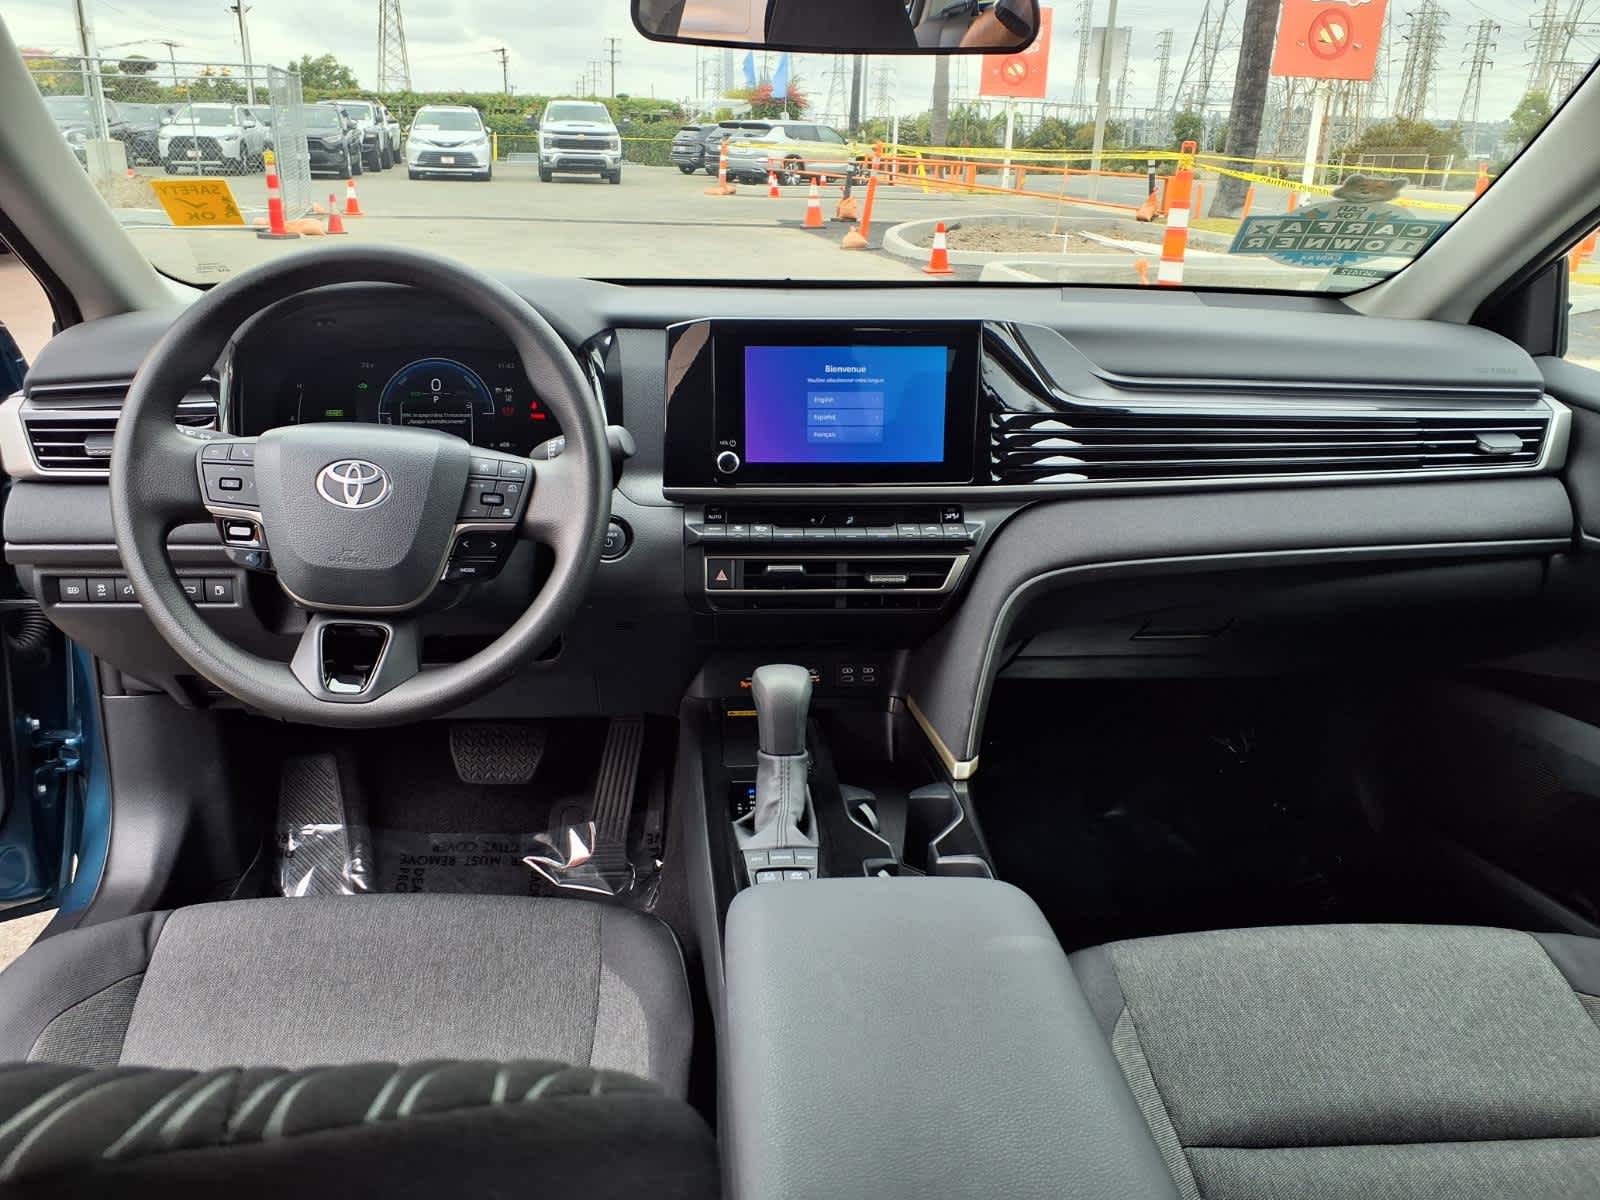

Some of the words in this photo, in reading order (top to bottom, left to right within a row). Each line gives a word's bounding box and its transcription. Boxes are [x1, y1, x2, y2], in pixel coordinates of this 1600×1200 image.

[825, 365, 866, 373] Bienvenue
[431, 378, 441, 391] 0
[464, 855, 501, 866] MUST
